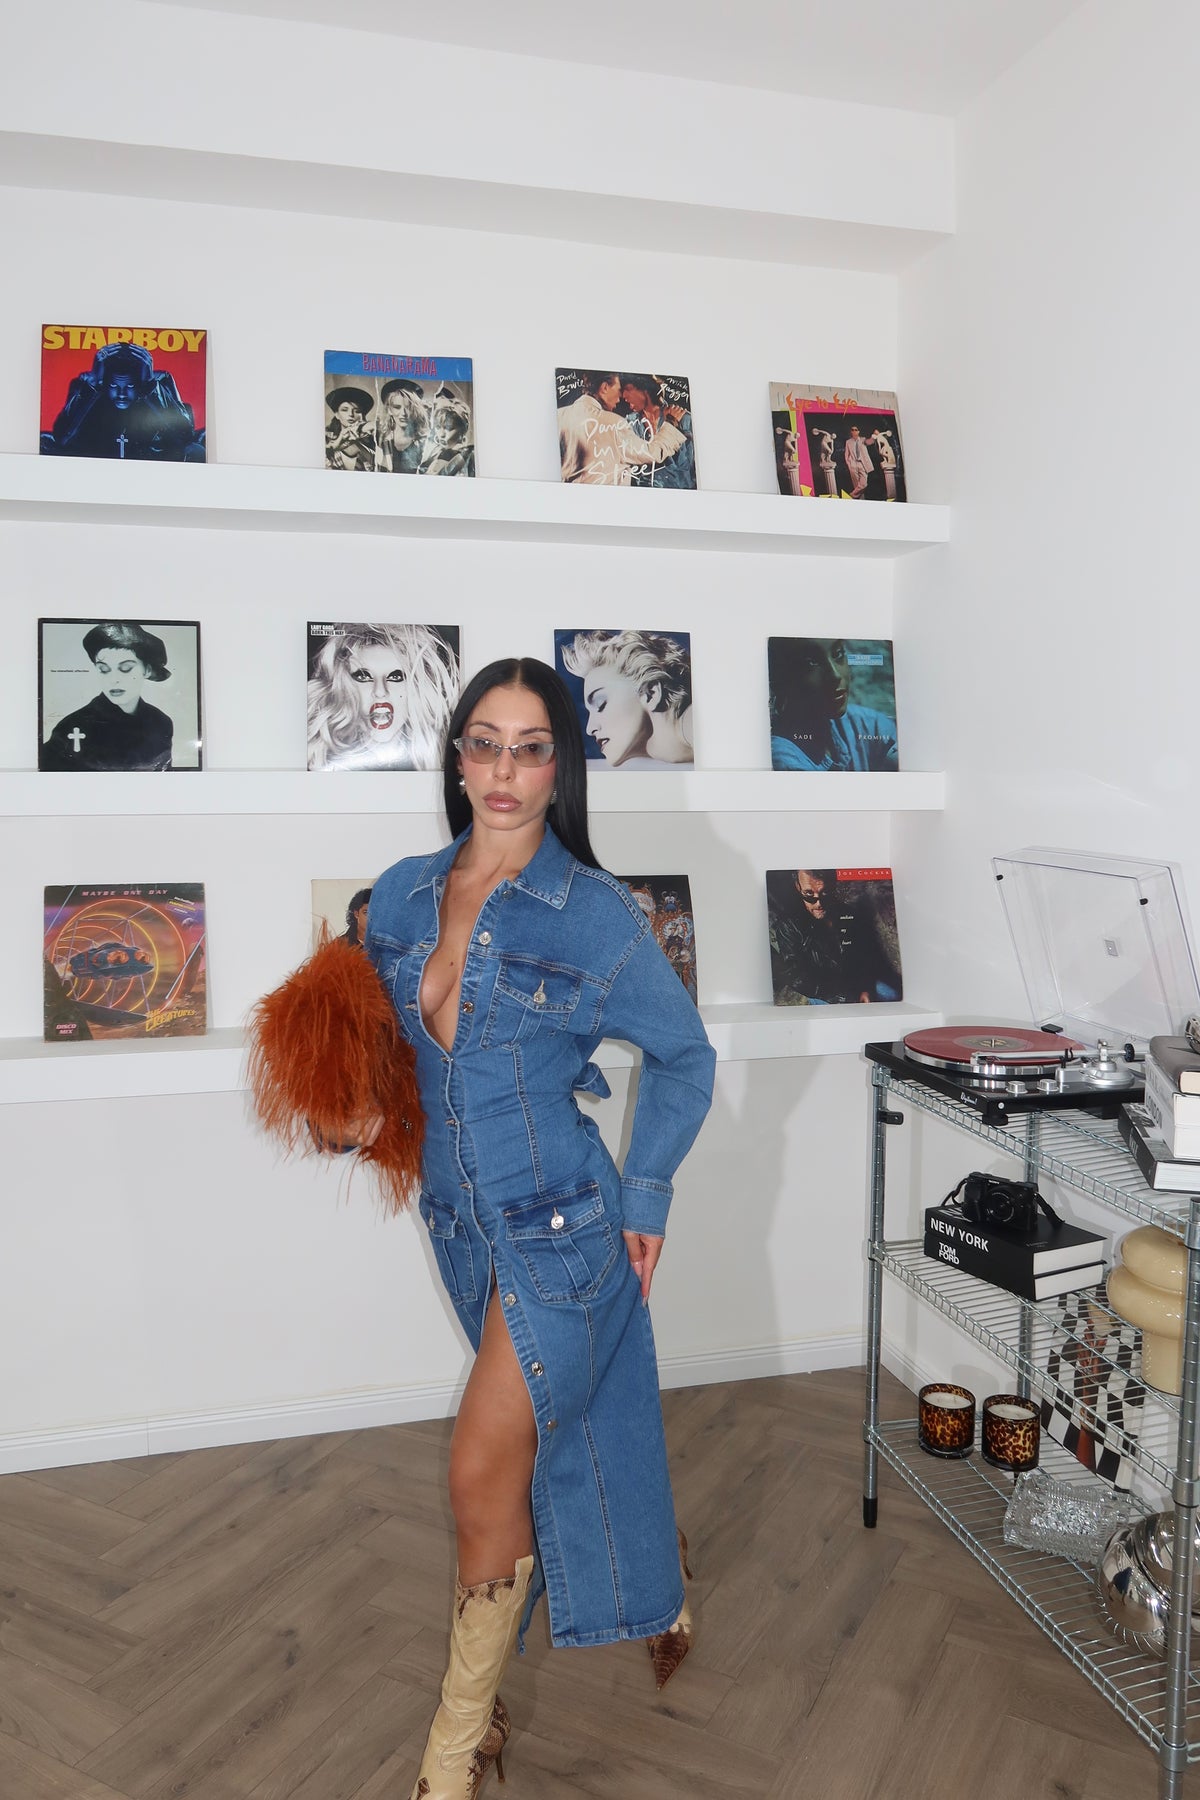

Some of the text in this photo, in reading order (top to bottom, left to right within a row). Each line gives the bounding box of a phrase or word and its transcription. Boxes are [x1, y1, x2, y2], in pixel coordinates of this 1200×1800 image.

[43, 325, 206, 353] STARBOY
[557, 378, 585, 398] Bowie
[583, 417, 654, 444] Dancing
[593, 440, 615, 458] in
[930, 1217, 989, 1253] NEW YORK
[938, 1241, 956, 1256] TOM
[938, 1249, 960, 1265] FORD
